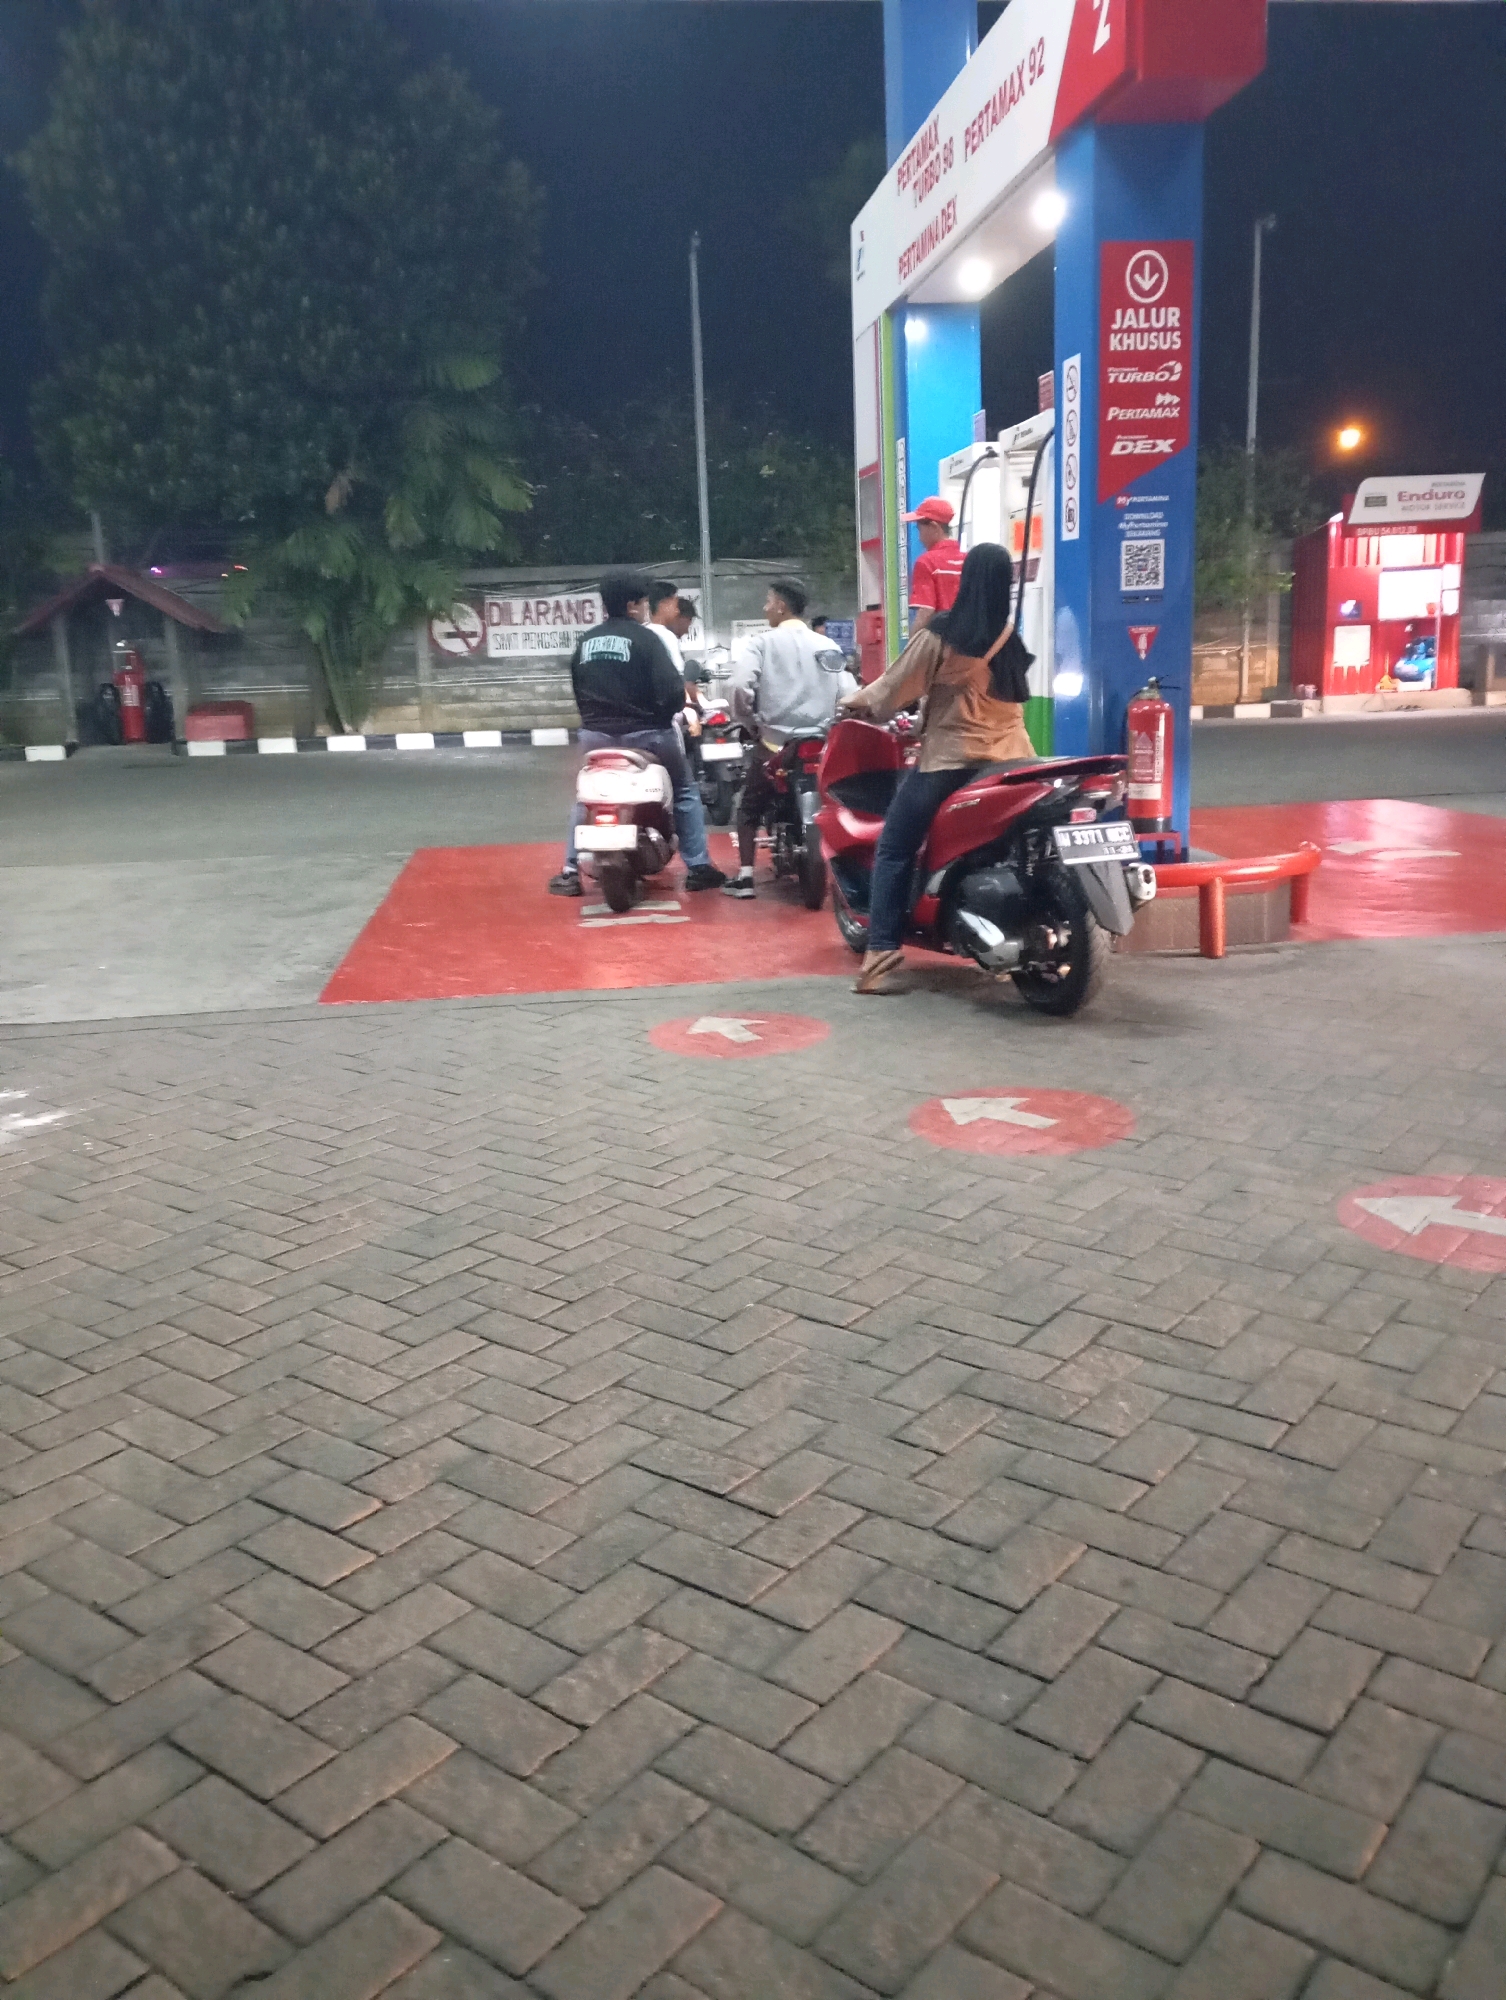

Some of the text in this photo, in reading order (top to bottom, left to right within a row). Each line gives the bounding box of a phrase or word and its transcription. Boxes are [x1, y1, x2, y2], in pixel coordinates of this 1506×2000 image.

[965, 36, 1045, 163] PERTAMAX 92
[898, 114, 940, 196] PERTAMAX
[913, 152, 942, 208] TURBO
[898, 194, 958, 285] PERTAMINA DEX
[1111, 307, 1180, 330] JALUR
[1109, 331, 1182, 351] KHUSUS
[1108, 371, 1170, 383] TURBO
[1106, 407, 1180, 421] PERTAMAX
[1110, 439, 1176, 455] DEX
[1397, 488, 1466, 502] Enduro
[486, 599, 596, 627] DILARANG
